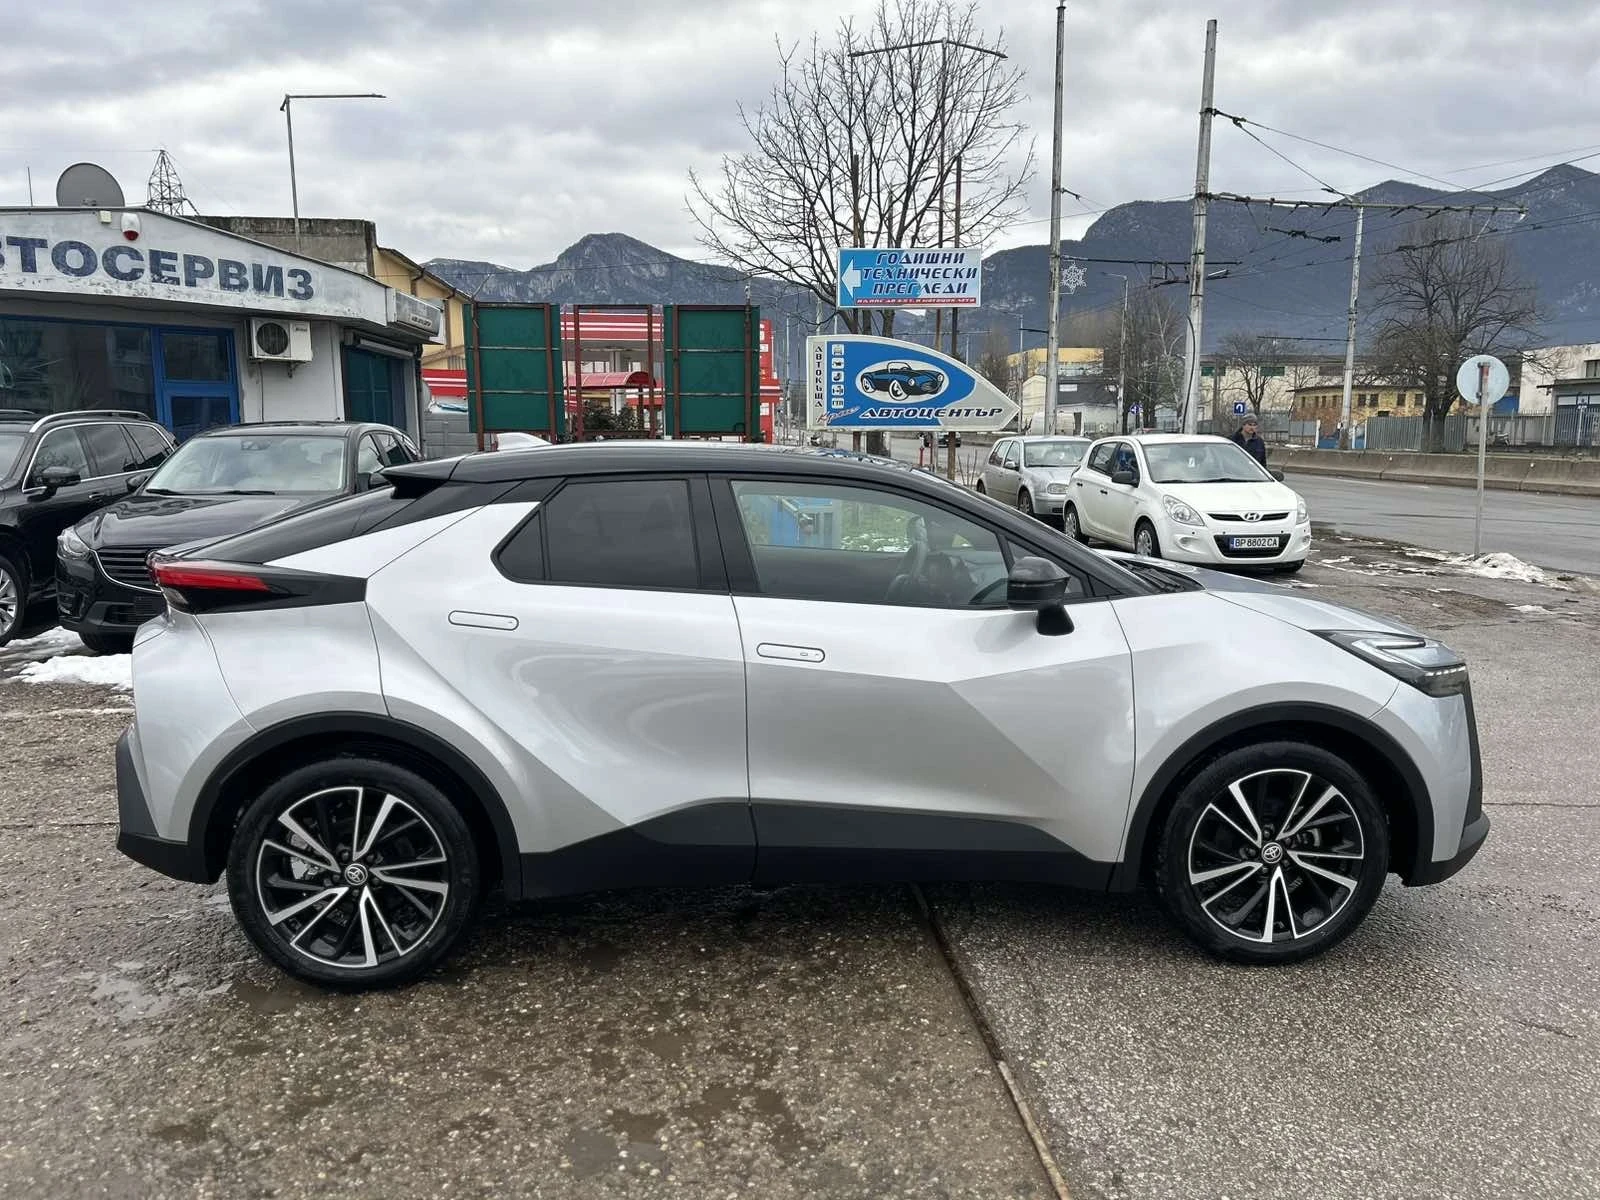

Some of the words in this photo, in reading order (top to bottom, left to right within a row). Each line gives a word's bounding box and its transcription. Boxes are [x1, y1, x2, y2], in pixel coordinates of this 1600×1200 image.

[876, 252, 965, 265] ГОДИШНИ
[0, 236, 314, 300] ТОСЕРВИЗ
[863, 267, 978, 279] ТЕХНИЧЕСКИ
[873, 282, 968, 294] ПРЕГЛЕДИ
[860, 408, 1003, 418] АВТОЦЕНТЪР
